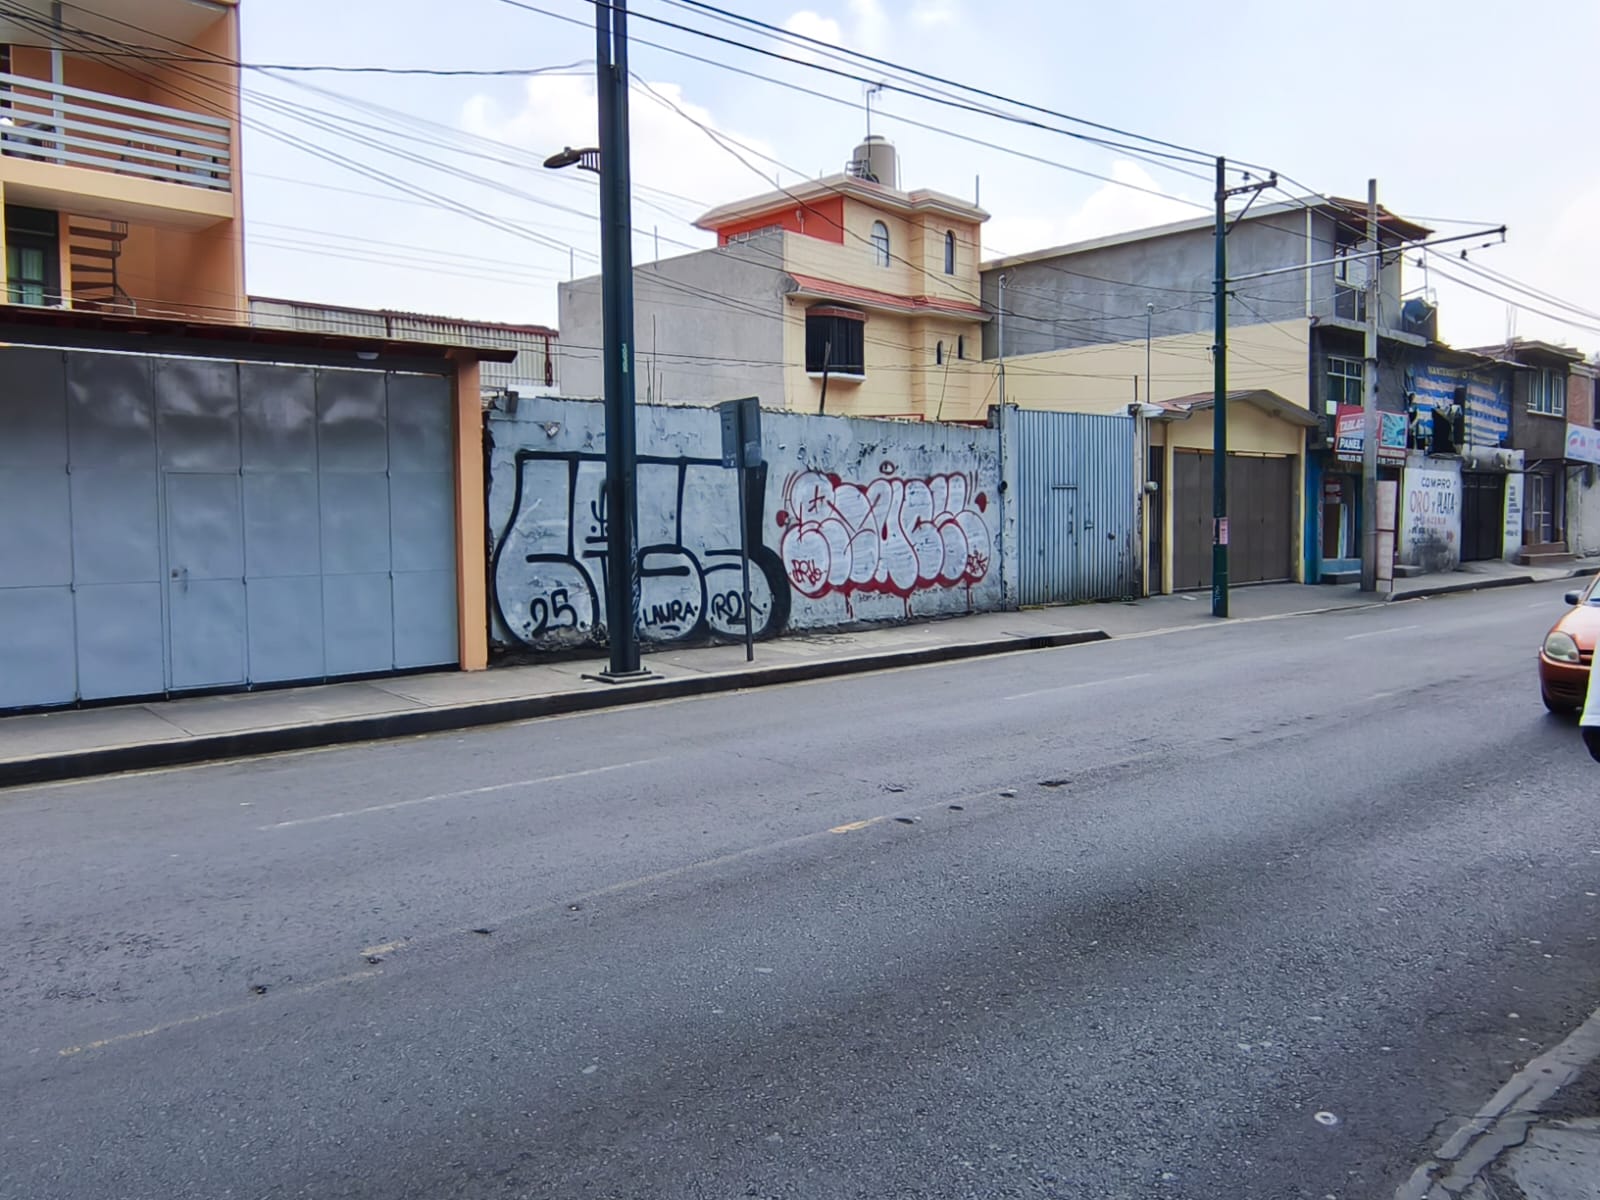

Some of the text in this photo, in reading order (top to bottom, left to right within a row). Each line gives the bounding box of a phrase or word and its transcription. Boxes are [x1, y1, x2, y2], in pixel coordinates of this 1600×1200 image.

[1339, 437, 1361, 450] PANEL
[1421, 477, 1451, 489] COMPRO
[1410, 490, 1430, 513] ORO
[1437, 491, 1455, 515] PLATA
